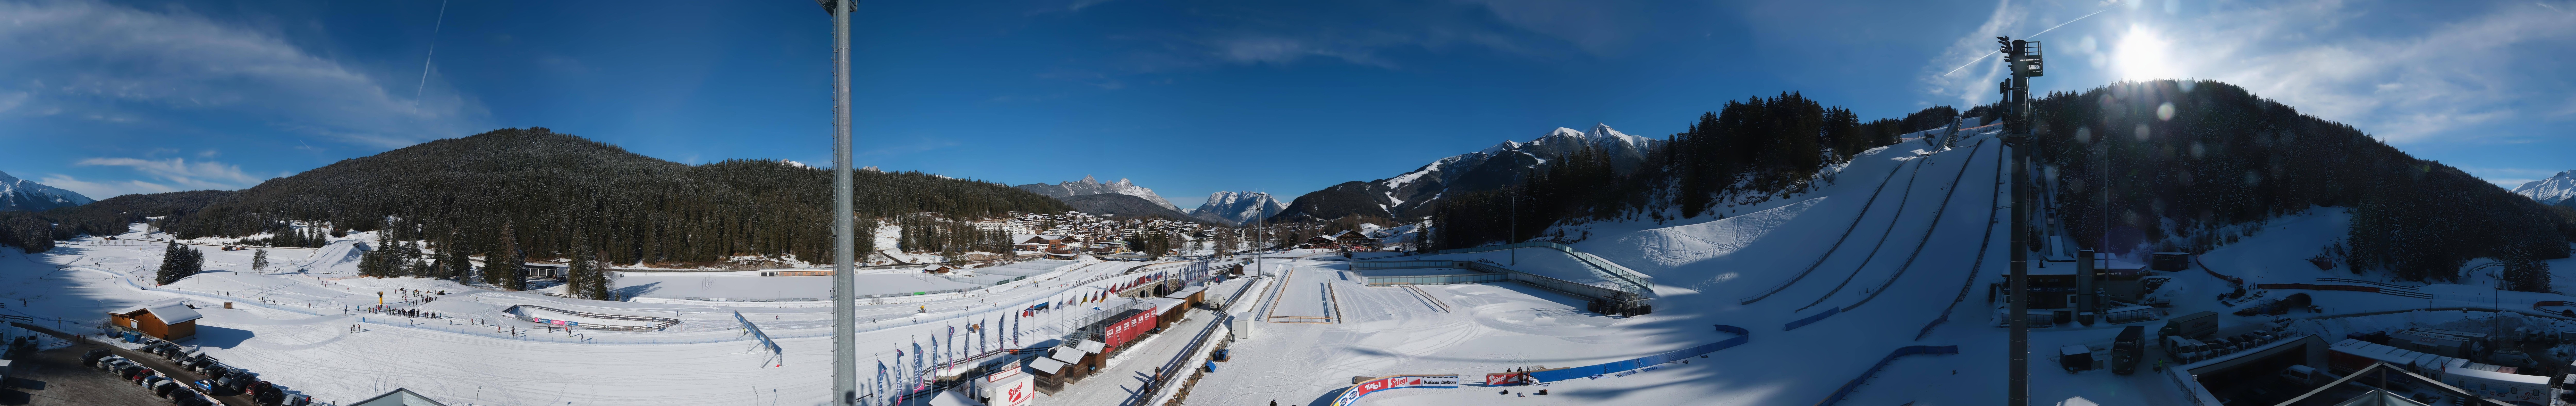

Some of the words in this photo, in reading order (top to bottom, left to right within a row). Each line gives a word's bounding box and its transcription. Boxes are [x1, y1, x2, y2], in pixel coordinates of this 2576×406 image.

[1391, 377, 1408, 388] Stiegl
[1489, 375, 1506, 385] Stiegl
[1009, 382, 1022, 402] Stiegl
